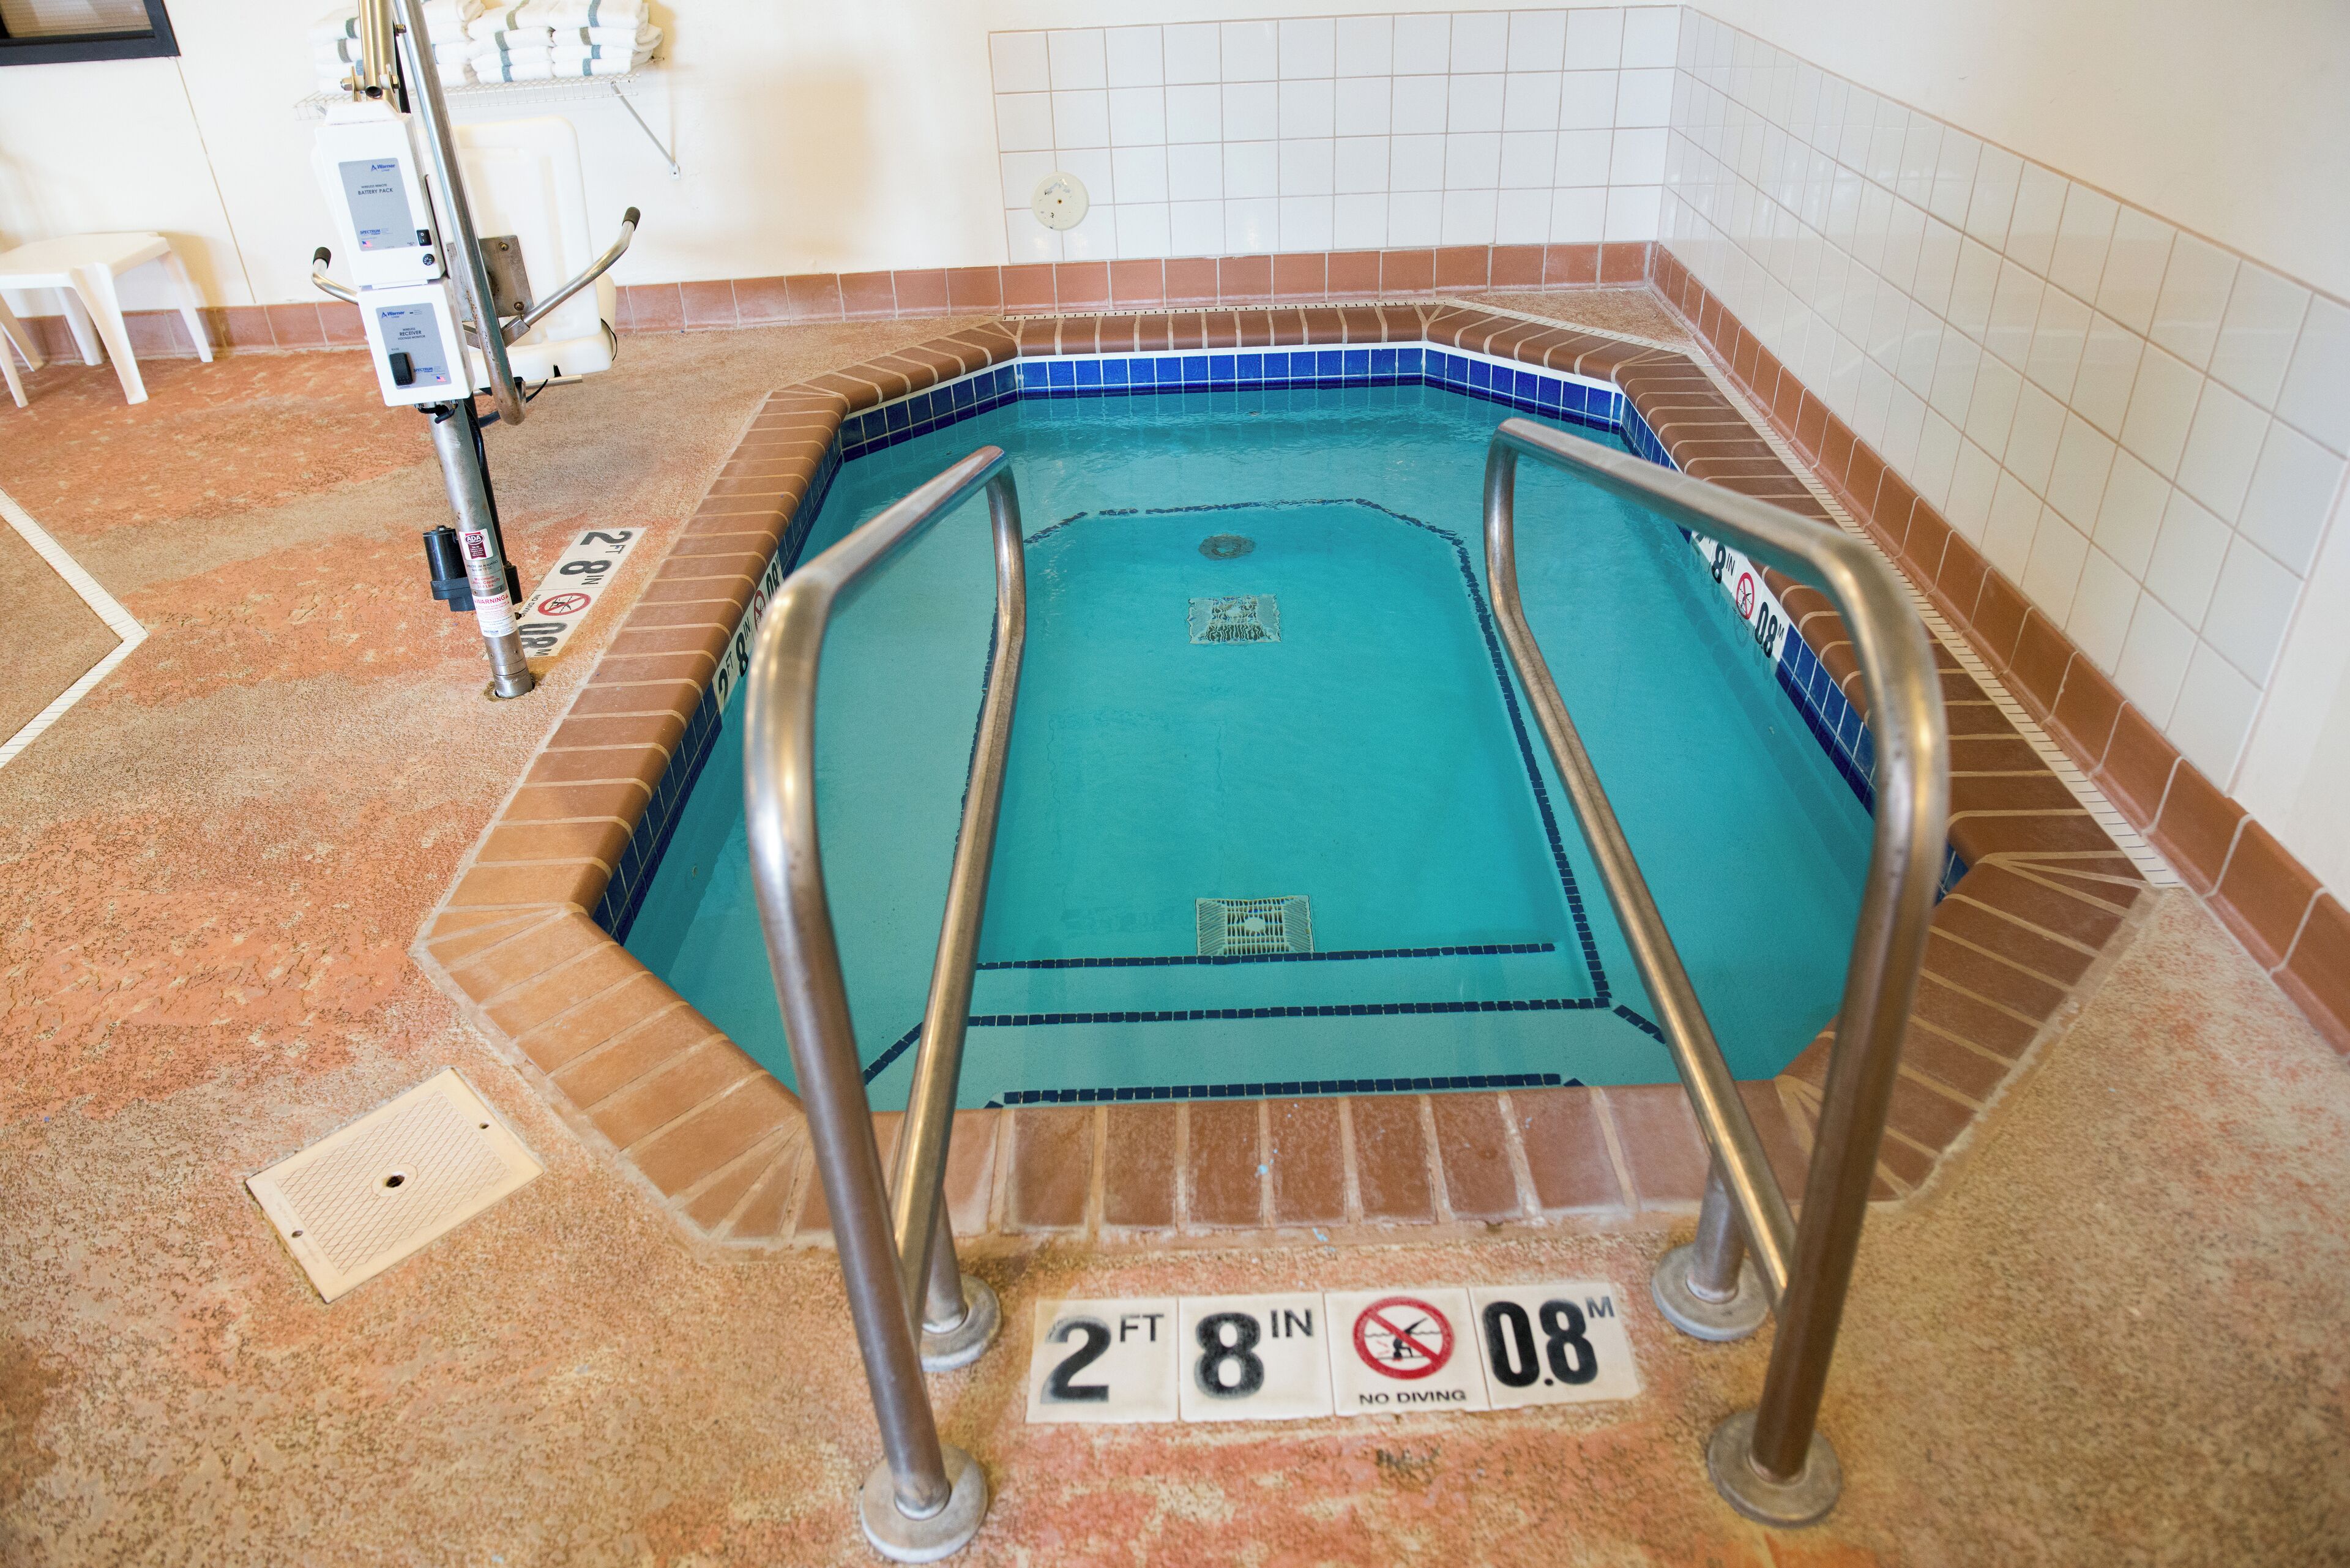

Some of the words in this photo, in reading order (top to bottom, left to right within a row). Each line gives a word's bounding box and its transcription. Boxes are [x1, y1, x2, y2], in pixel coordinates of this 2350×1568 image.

[580, 531, 633, 545] 2
[605, 544, 627, 554] FT
[559, 559, 612, 575] 8
[1711, 542, 1726, 584] 8
[1726, 553, 1736, 576] IN
[581, 575, 604, 585] IN
[476, 595, 505, 604] WARNING
[1777, 623, 1785, 641] M
[534, 648, 552, 657] M
[736, 632, 749, 678] 8
[743, 616, 751, 641] IN
[726, 651, 733, 677] FT
[1482, 1298, 1598, 1388] 0.8
[1585, 1295, 1615, 1320] M
[1040, 1315, 1112, 1404] 2
[1119, 1312, 1165, 1343] FT
[1193, 1311, 1265, 1401] 8
[1270, 1308, 1315, 1339] IN
[1359, 1392, 1390, 1406] NO
[1396, 1389, 1467, 1404] DIVING
